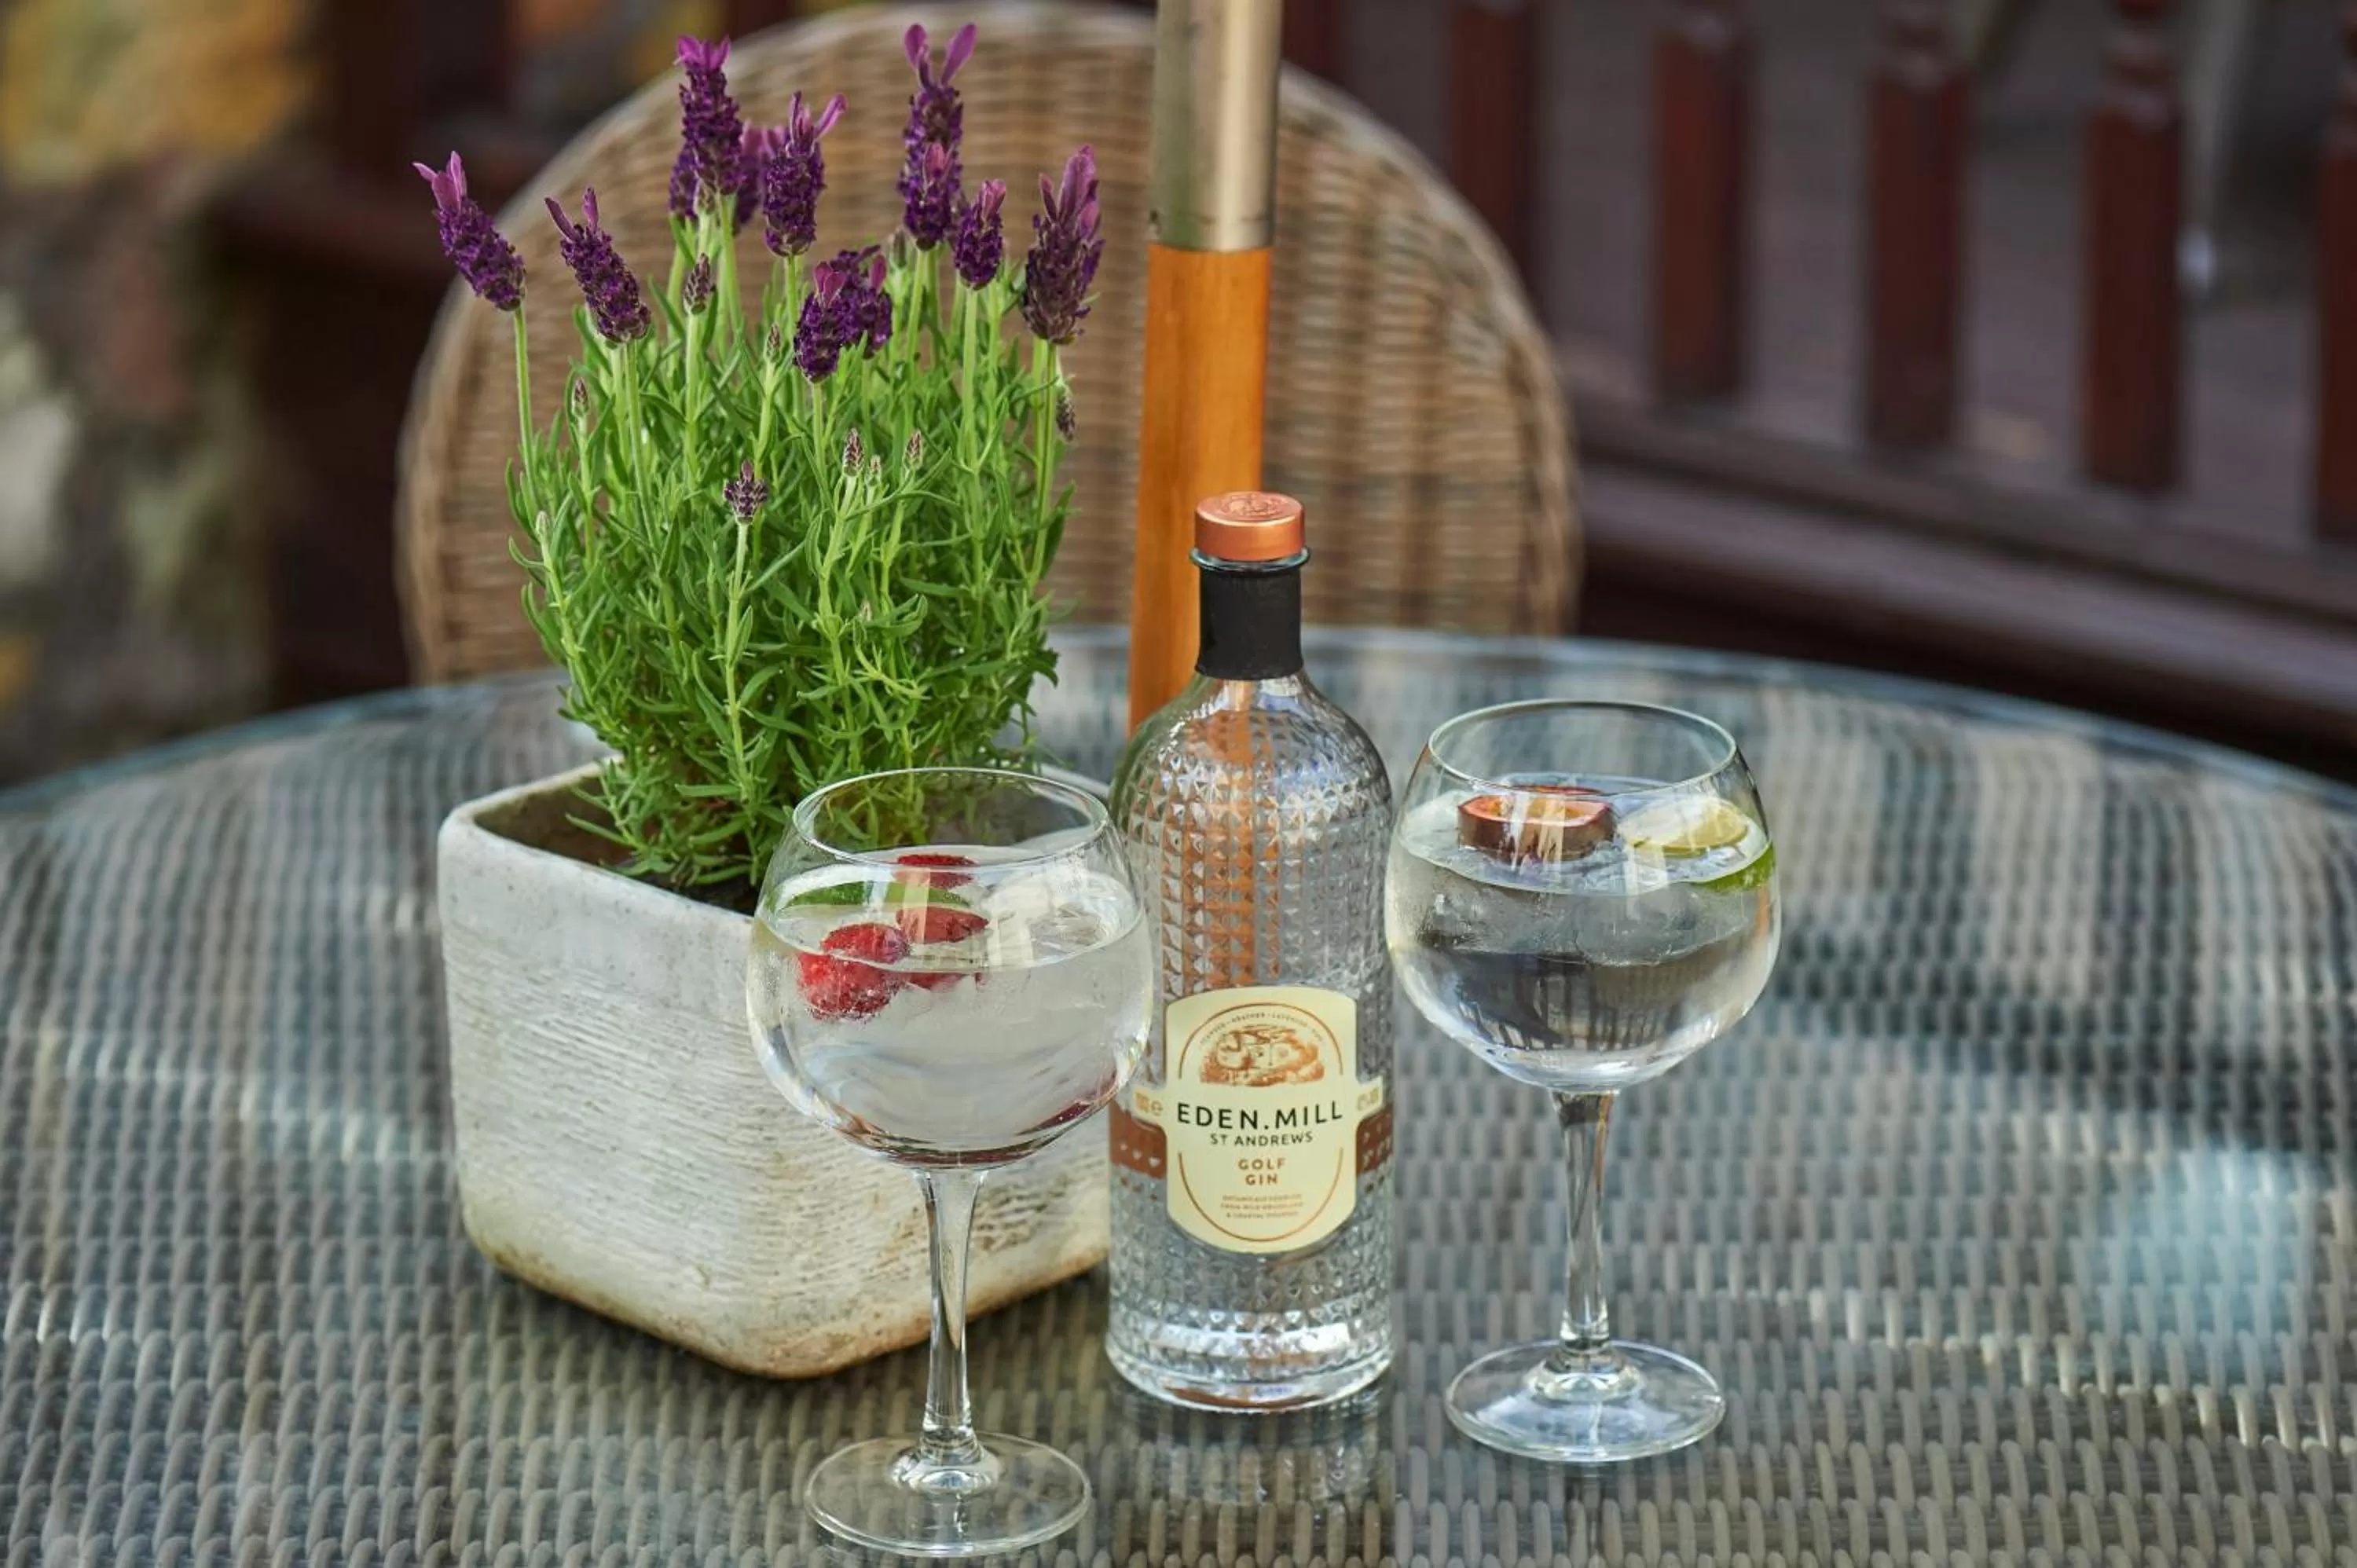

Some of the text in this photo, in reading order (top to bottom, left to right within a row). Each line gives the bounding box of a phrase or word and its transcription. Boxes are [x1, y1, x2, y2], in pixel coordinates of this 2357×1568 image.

[1210, 1131, 1314, 1147] ST ANDREWS
[1237, 1157, 1286, 1171] GOLF
[1244, 1173, 1278, 1186] GIN
